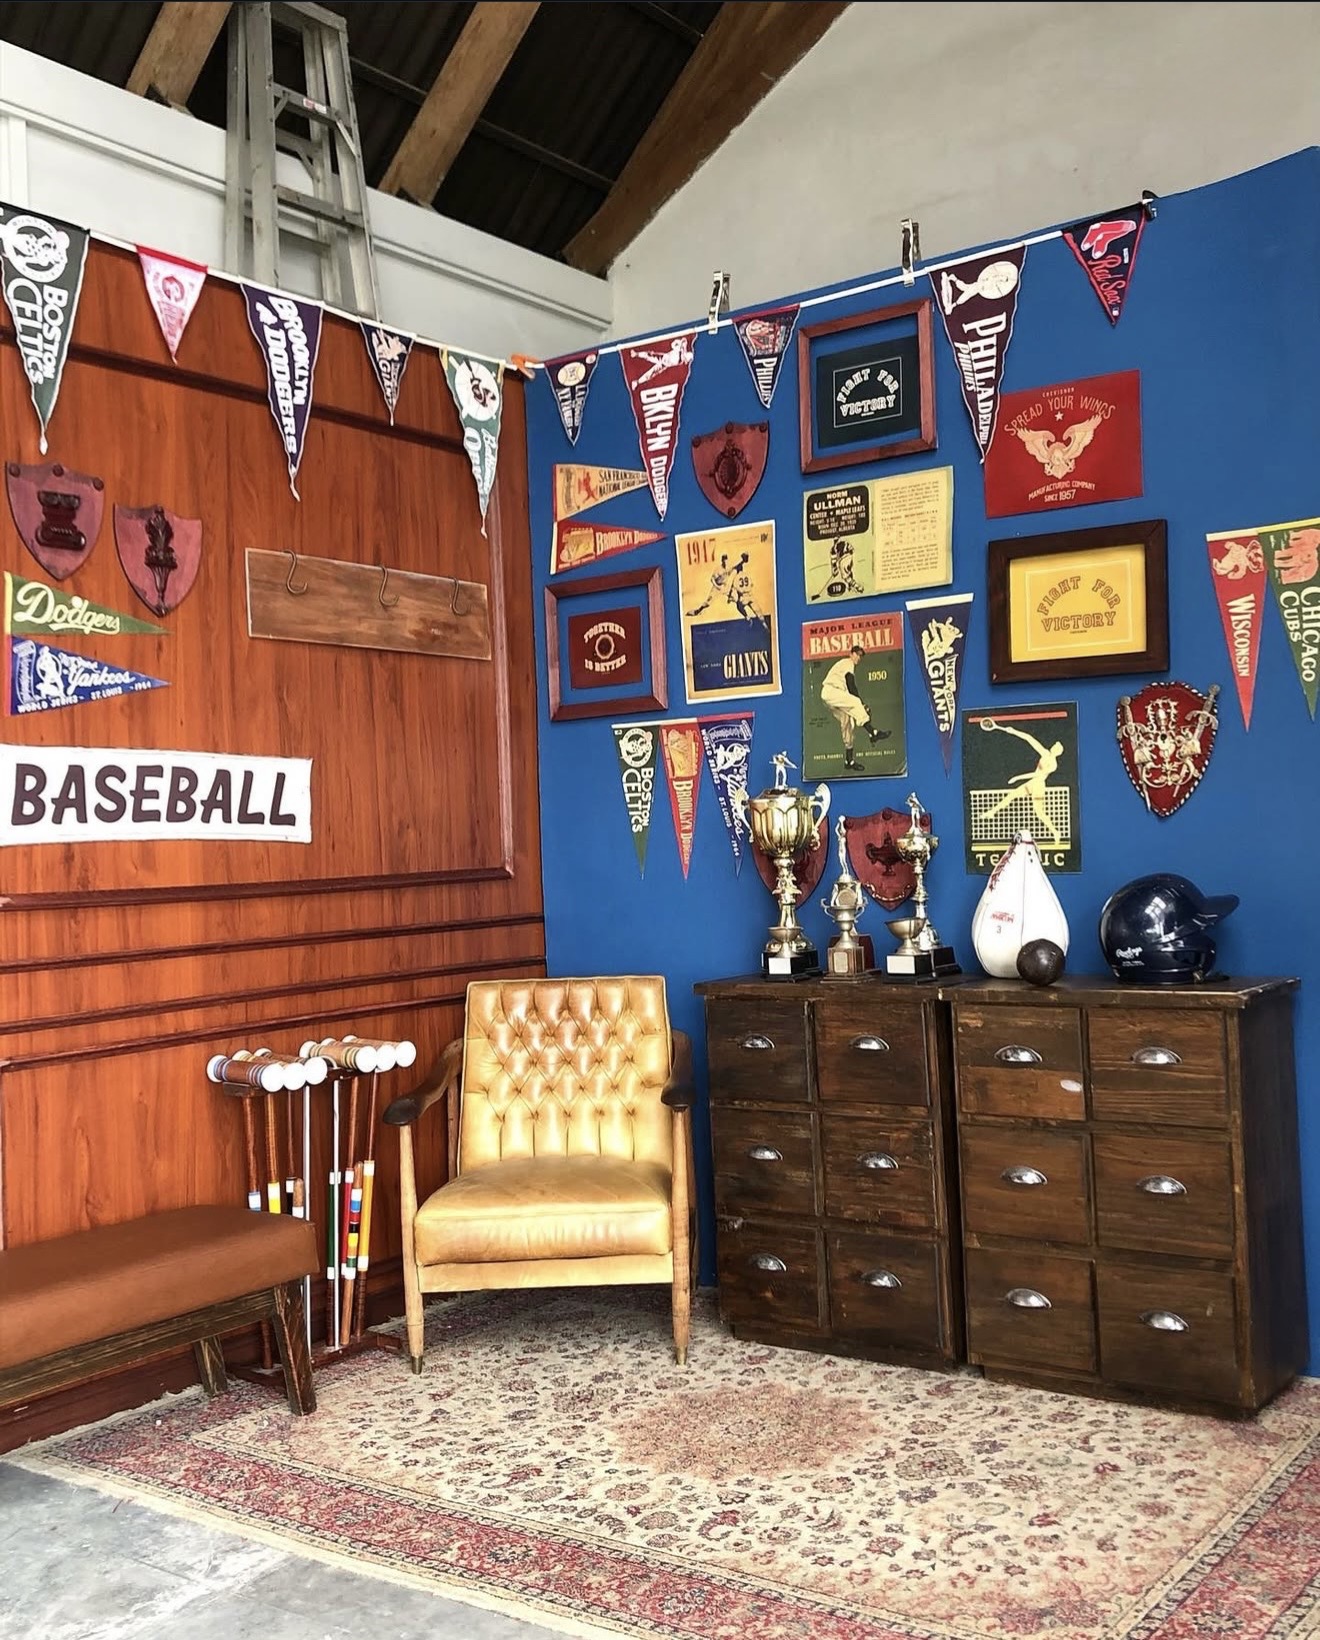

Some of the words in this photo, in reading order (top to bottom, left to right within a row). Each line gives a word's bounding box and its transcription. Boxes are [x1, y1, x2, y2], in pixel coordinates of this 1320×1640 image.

[1087, 254, 1124, 283] Red
[1099, 279, 1127, 306] Sox
[7, 278, 44, 385] CELTICS
[43, 284, 69, 379] BOSTON
[268, 296, 309, 405] BROOKLYN
[953, 341, 978, 392] PHILLIES
[263, 325, 297, 453] DODGERS
[754, 357, 778, 401] PHILLIES
[836, 368, 871, 403] FIGHT
[877, 369, 900, 394] FOR
[961, 311, 1007, 444] PHILADELPHIA
[640, 383, 679, 451] BKLYN
[840, 394, 896, 417] VICTORY
[1004, 403, 1043, 436] SPREAD
[1049, 395, 1075, 411] YOUR
[1080, 396, 1116, 420] WINGS
[814, 496, 861, 511] ULLMAN
[827, 491, 848, 500] NORM
[1028, 480, 1071, 501] MANUFACTURING
[1071, 481, 1095, 492] COMPANY
[1044, 493, 1058, 503] SINCE
[1058, 489, 1076, 501] 1957
[595, 532, 633, 555] BROOKLYN
[739, 577, 749, 588] 39
[1037, 576, 1081, 616] FIGHT
[1092, 579, 1121, 609] FOR
[13, 582, 121, 635] Dodgers
[1041, 611, 1116, 632] VICTORY
[1279, 591, 1301, 643] CUBS
[584, 622, 626, 643] TOGETHER
[810, 624, 845, 635] MAJOR
[852, 618, 893, 630] LEAGUE
[810, 628, 894, 655] BASEBALL
[1225, 594, 1256, 677] WISCONSIN
[1300, 586, 1320, 682] CHICAGO
[63, 669, 136, 694] Yankees
[723, 650, 769, 680] GIANTS
[868, 670, 887, 681] 1950
[946, 660, 955, 683] NEW
[17, 698, 49, 714] WORLD
[928, 664, 950, 733] GIANTS
[701, 729, 712, 757] WORLD
[11, 763, 296, 826] BASEBALL
[622, 768, 643, 833] CELTICS
[640, 767, 654, 827] BOSTON
[673, 780, 695, 831] BROOKLYN
